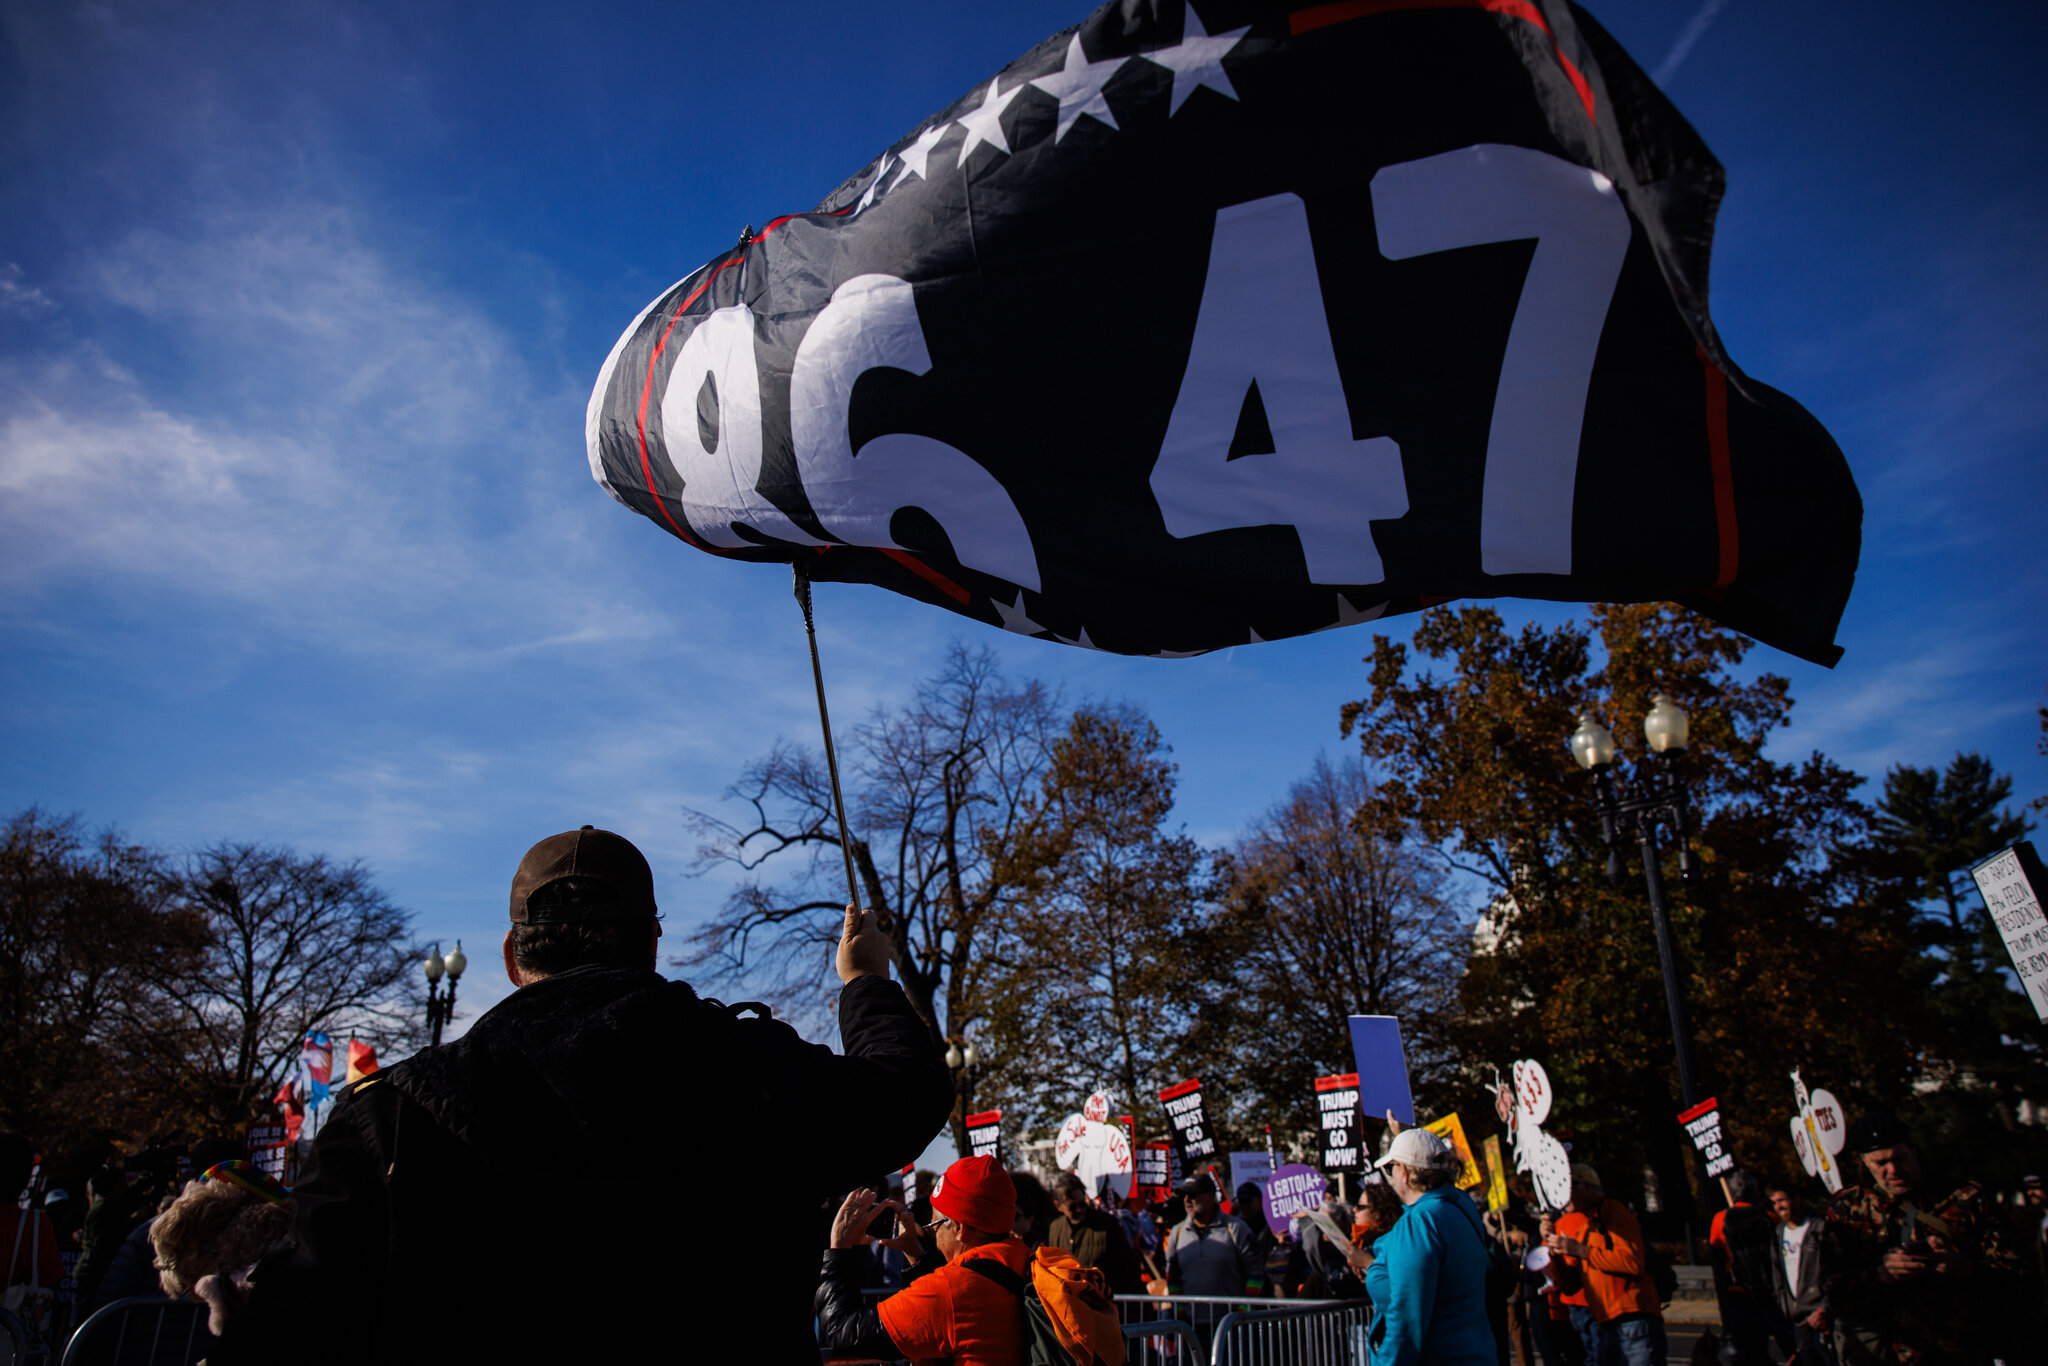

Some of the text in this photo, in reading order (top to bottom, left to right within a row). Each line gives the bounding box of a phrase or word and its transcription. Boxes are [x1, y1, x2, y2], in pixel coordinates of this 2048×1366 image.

[662, 143, 1632, 594] 86 47
[1164, 1092, 1203, 1117] TRUMP
[1317, 1090, 1359, 1112] TRUMP
[1173, 1108, 1205, 1131] MUST
[1321, 1109, 1355, 1130] MUST
[1684, 1110, 1720, 1138] TRUMP
[968, 1125, 1000, 1146] TRUMP
[1186, 1125, 1204, 1143] GO
[1329, 1128, 1348, 1148] GO
[1694, 1125, 1722, 1151] MUST
[1109, 1132, 1129, 1175] USA
[1324, 1147, 1357, 1168] NOW!
[1705, 1143, 1722, 1161] GO
[1705, 1153, 1734, 1178] NOW!
[1267, 1173, 1322, 1200] LGBTQIA+
[1270, 1190, 1324, 1218] EQUALITY
